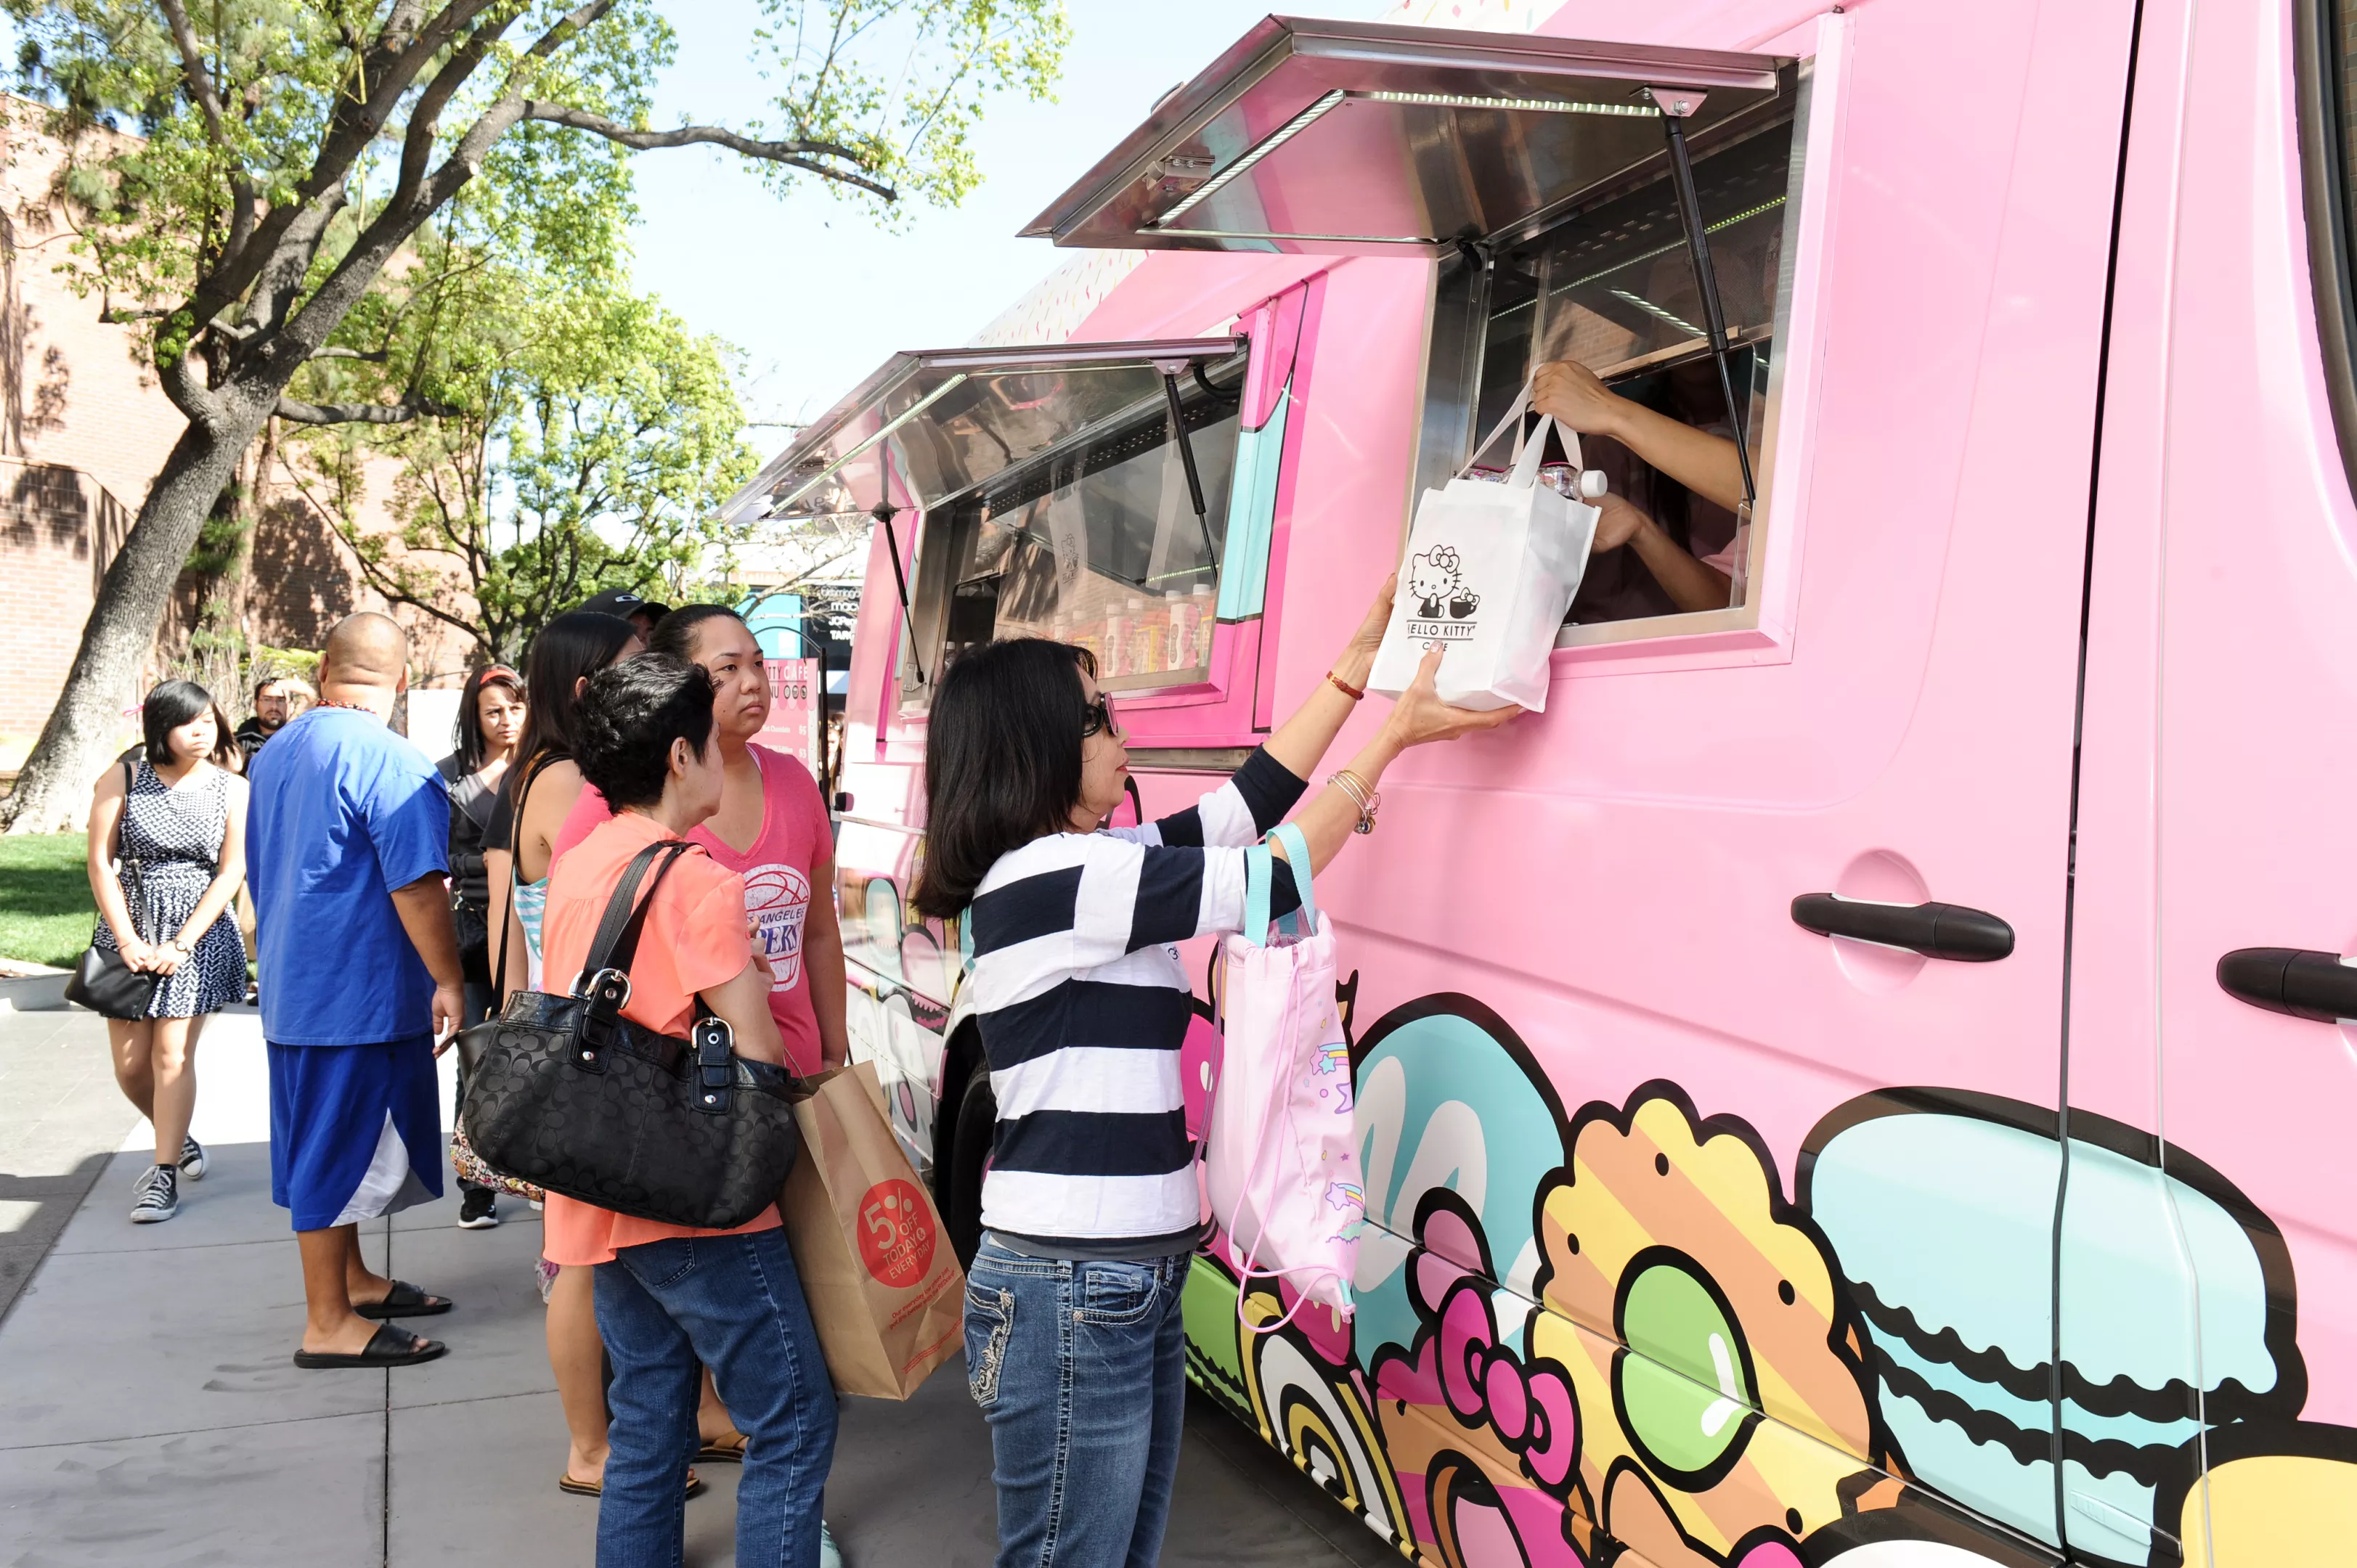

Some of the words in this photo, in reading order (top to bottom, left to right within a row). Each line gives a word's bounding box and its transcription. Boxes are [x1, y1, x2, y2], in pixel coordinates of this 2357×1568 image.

[1422, 642, 1448, 651] CE
[784, 666, 807, 680] CAFE
[864, 1187, 913, 1249] 5%
[900, 1211, 918, 1236] OFF
[883, 1234, 917, 1267] TODAY
[889, 1254, 918, 1280] EVERY
[917, 1239, 930, 1258] DAY
[892, 1309, 901, 1318] Our
